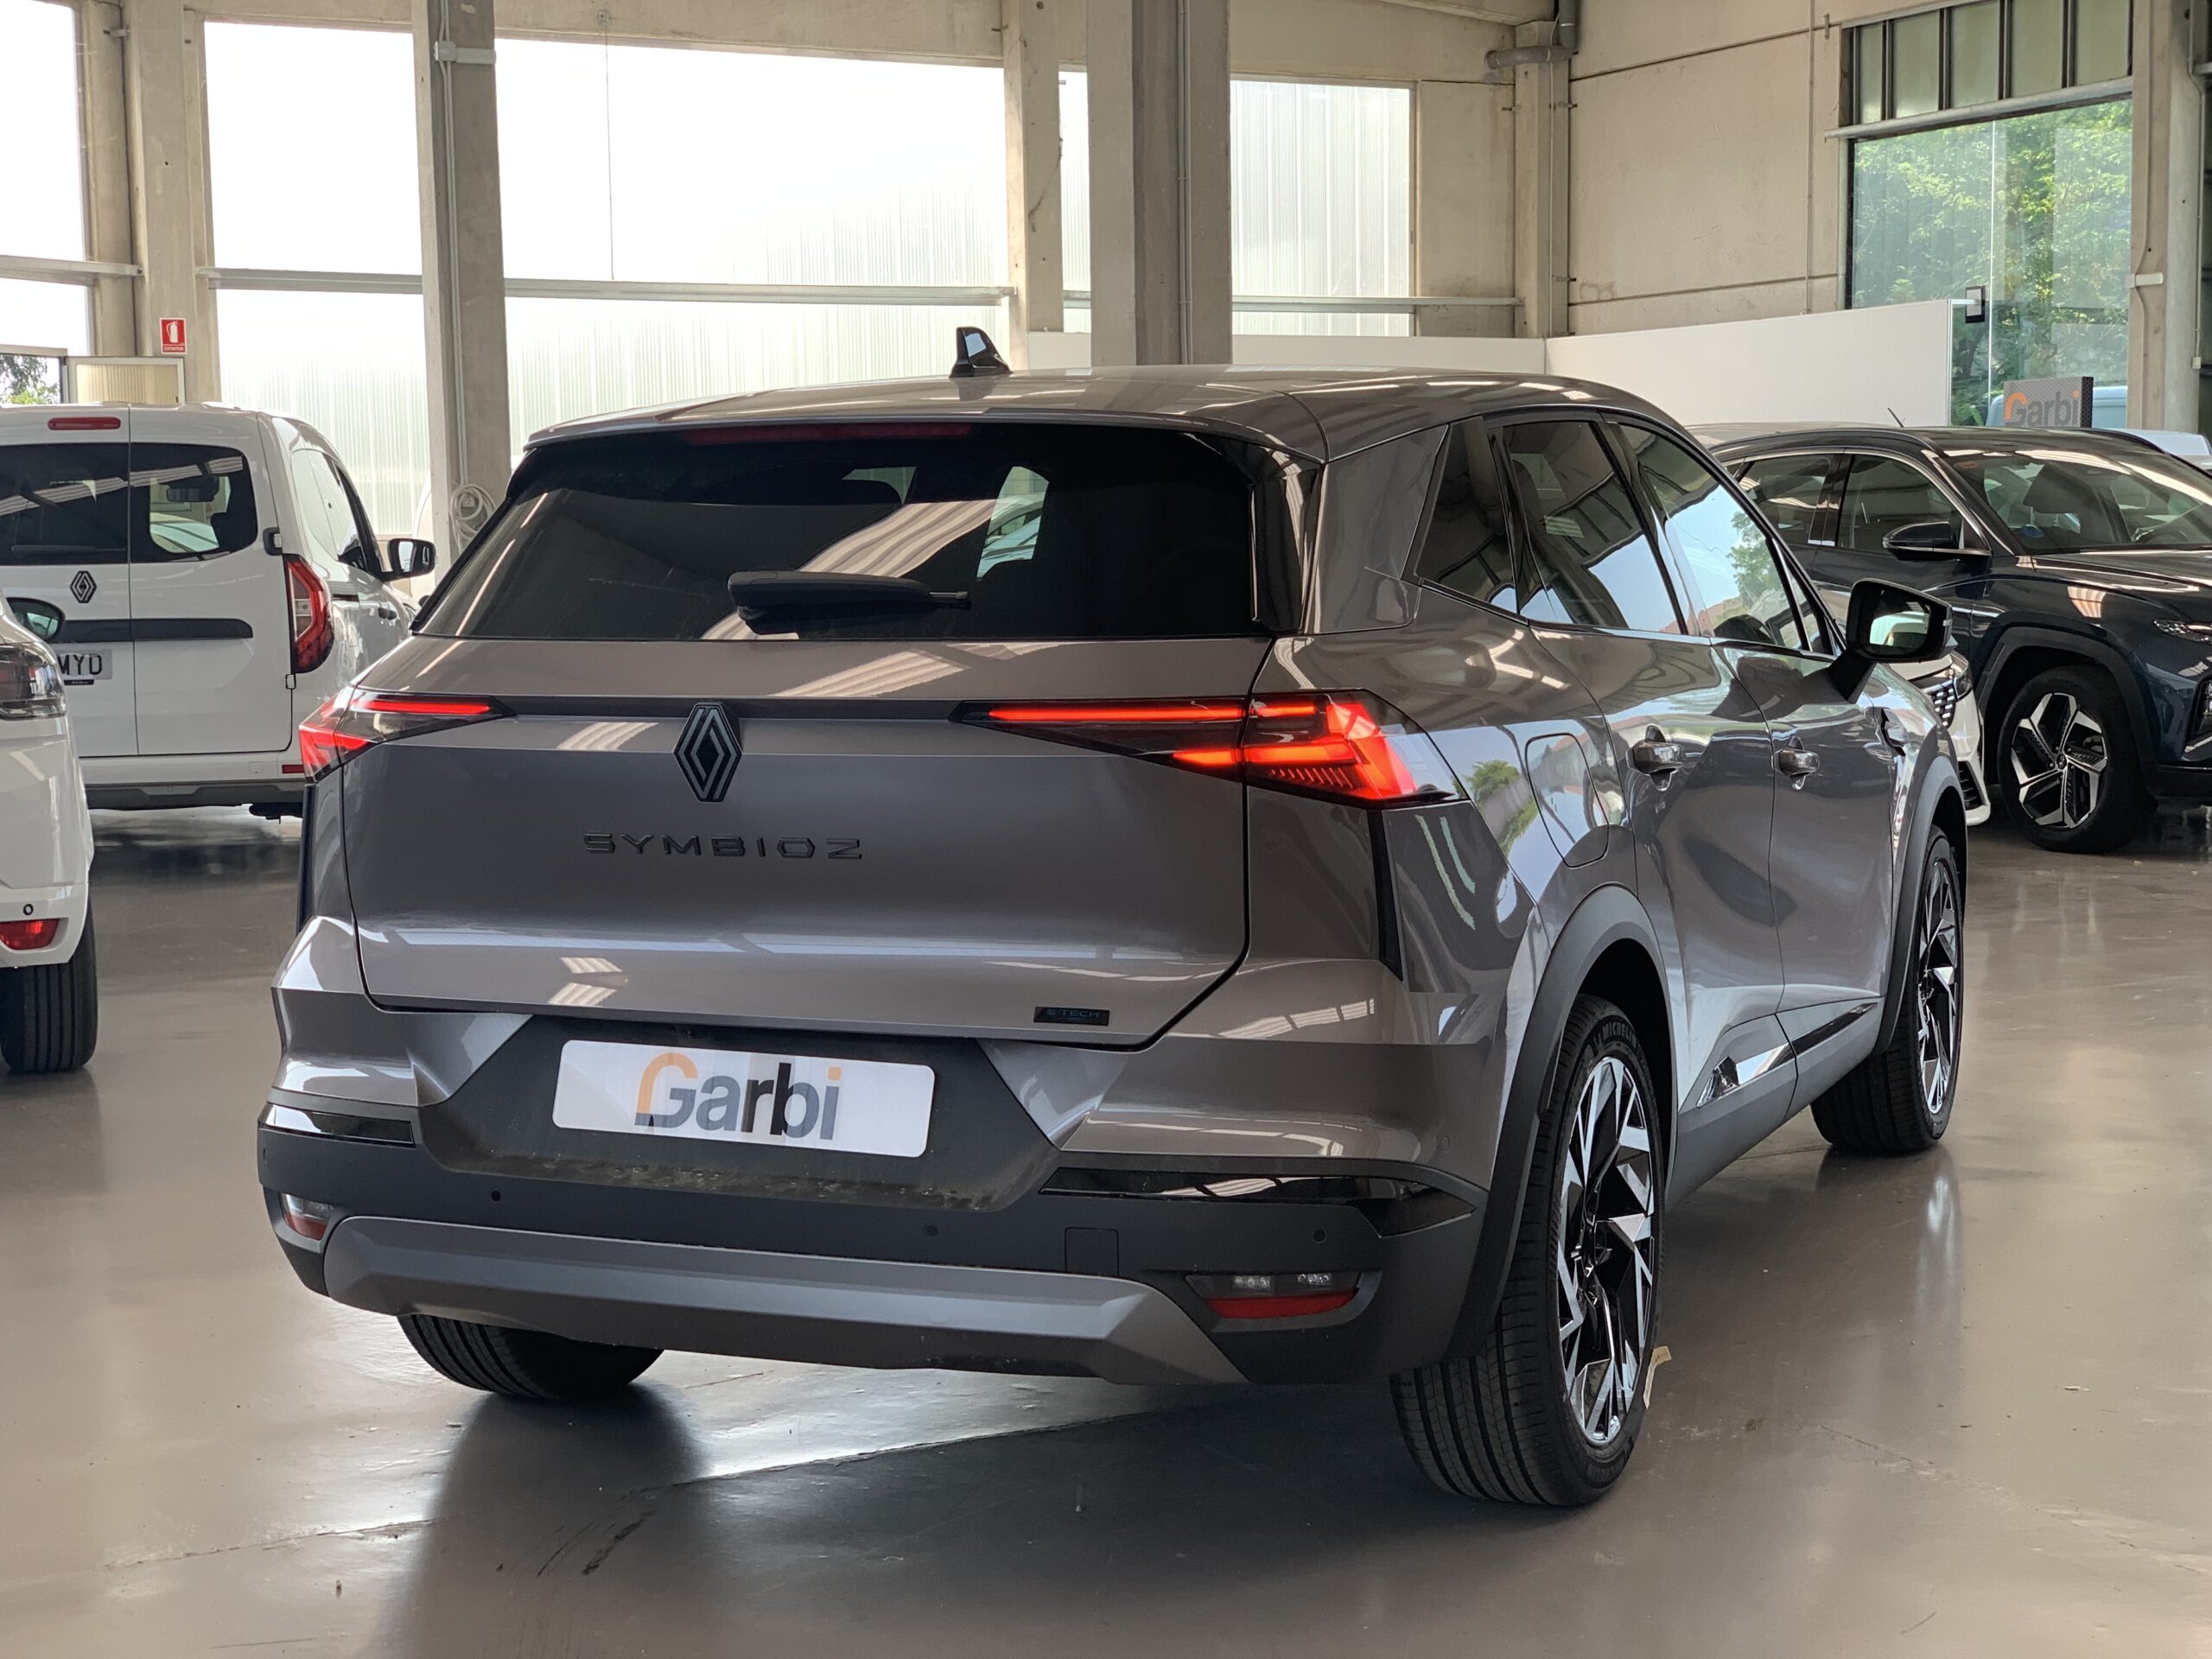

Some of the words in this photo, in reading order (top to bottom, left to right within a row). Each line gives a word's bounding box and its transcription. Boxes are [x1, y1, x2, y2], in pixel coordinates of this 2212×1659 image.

[2005, 391, 2079, 427] Garbi
[56, 653, 102, 675] MYD
[583, 832, 862, 860] SYMBIOZ
[1046, 1008, 1100, 1019] E-TECH
[1602, 1021, 1637, 1048] MICHELIN
[634, 1052, 842, 1141] Garbi
